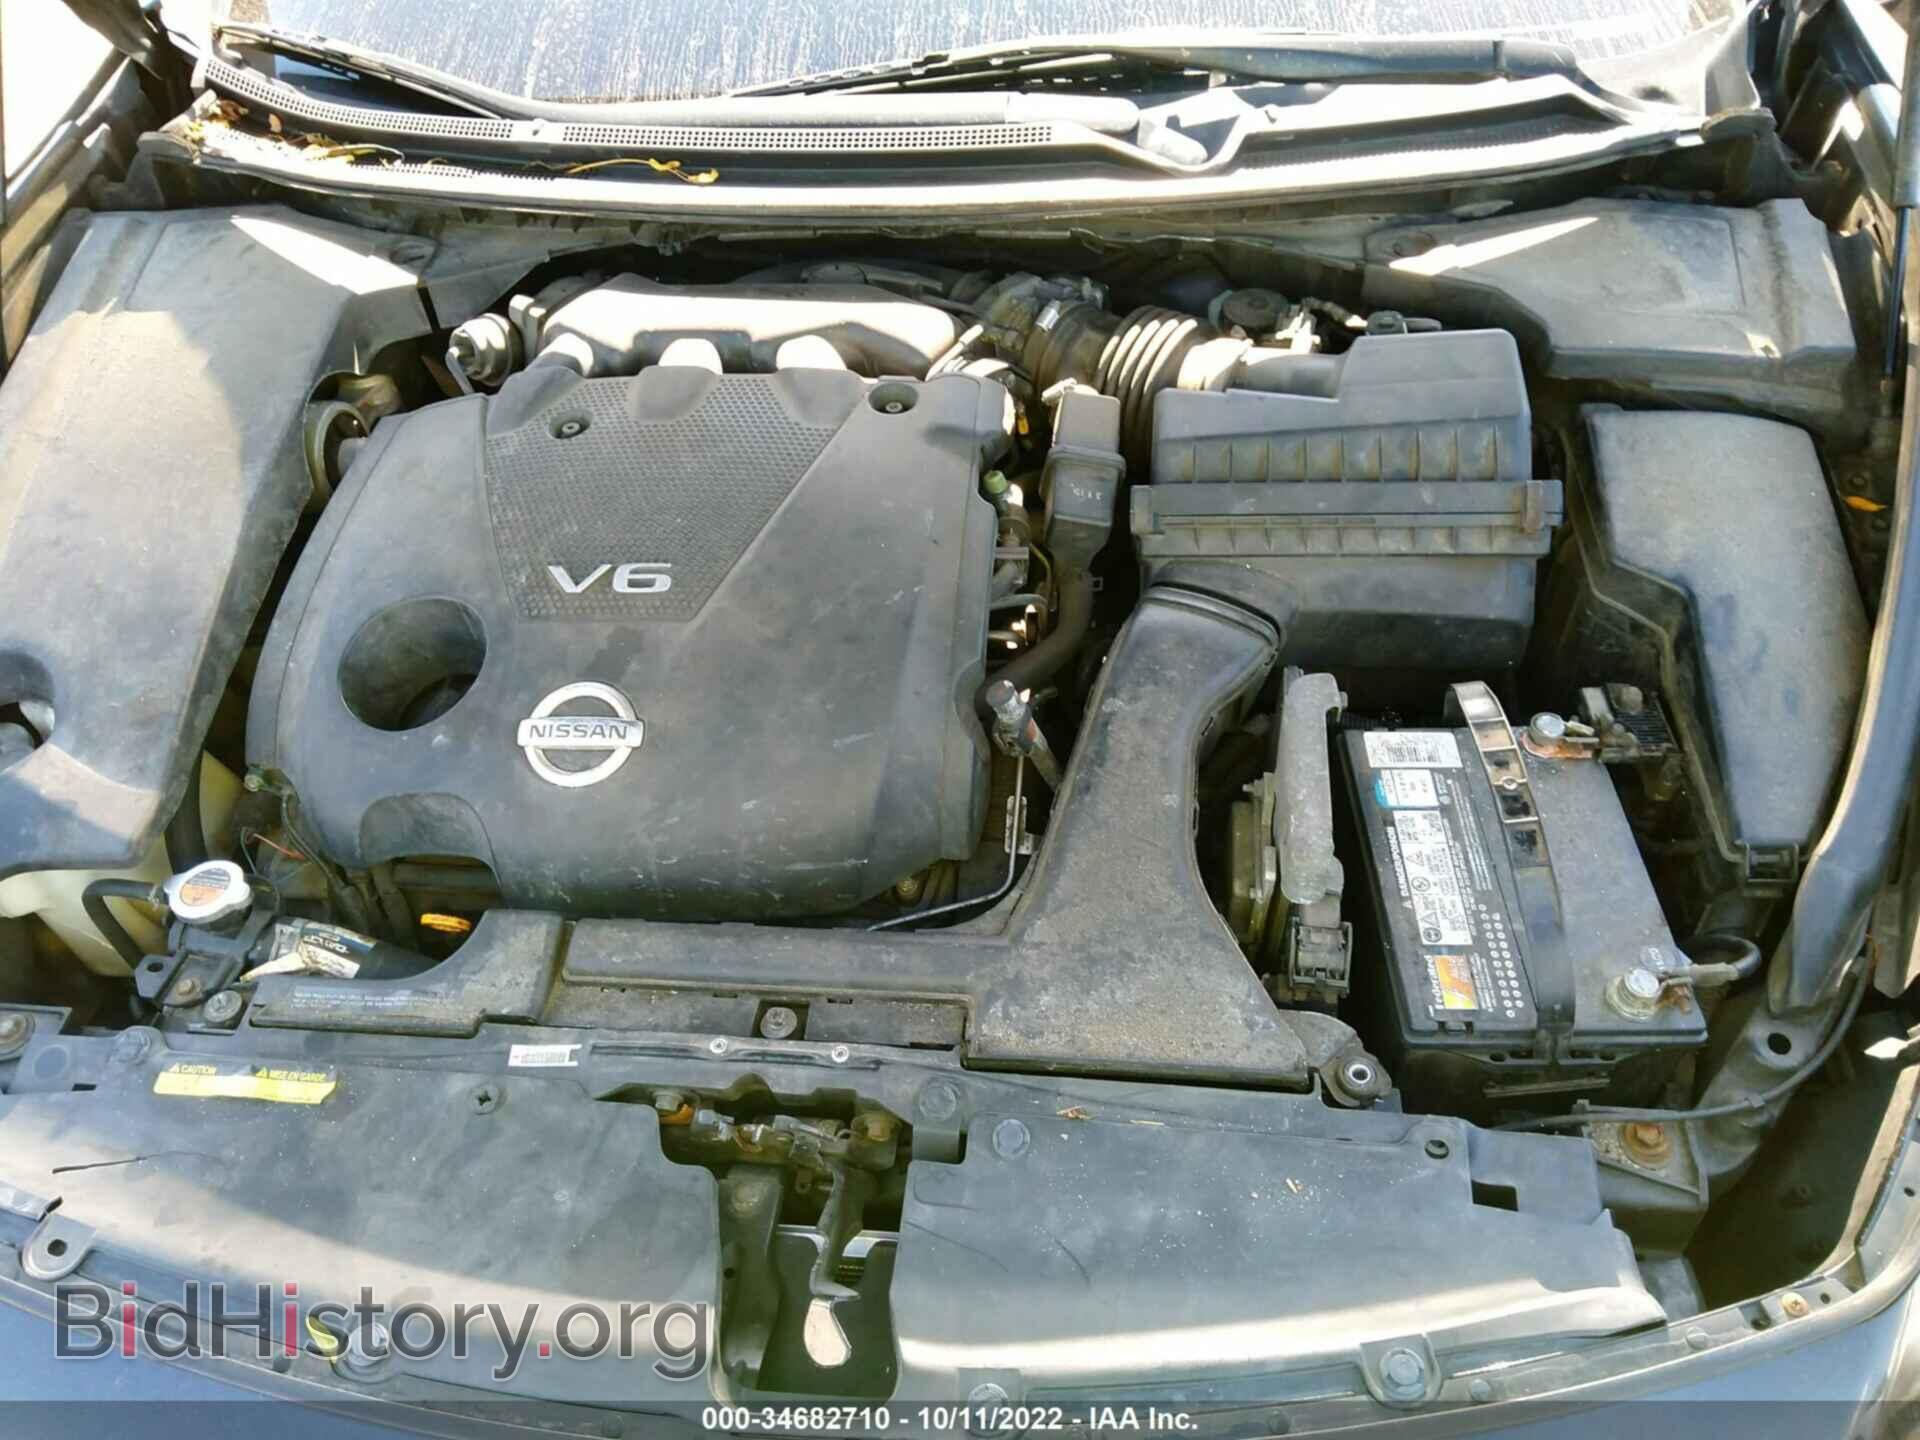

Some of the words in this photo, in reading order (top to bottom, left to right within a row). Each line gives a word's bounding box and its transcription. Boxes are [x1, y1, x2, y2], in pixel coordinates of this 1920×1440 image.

[548, 562, 673, 594] V6
[529, 723, 629, 741] NISSAN
[181, 1064, 217, 1075] CAUTION
